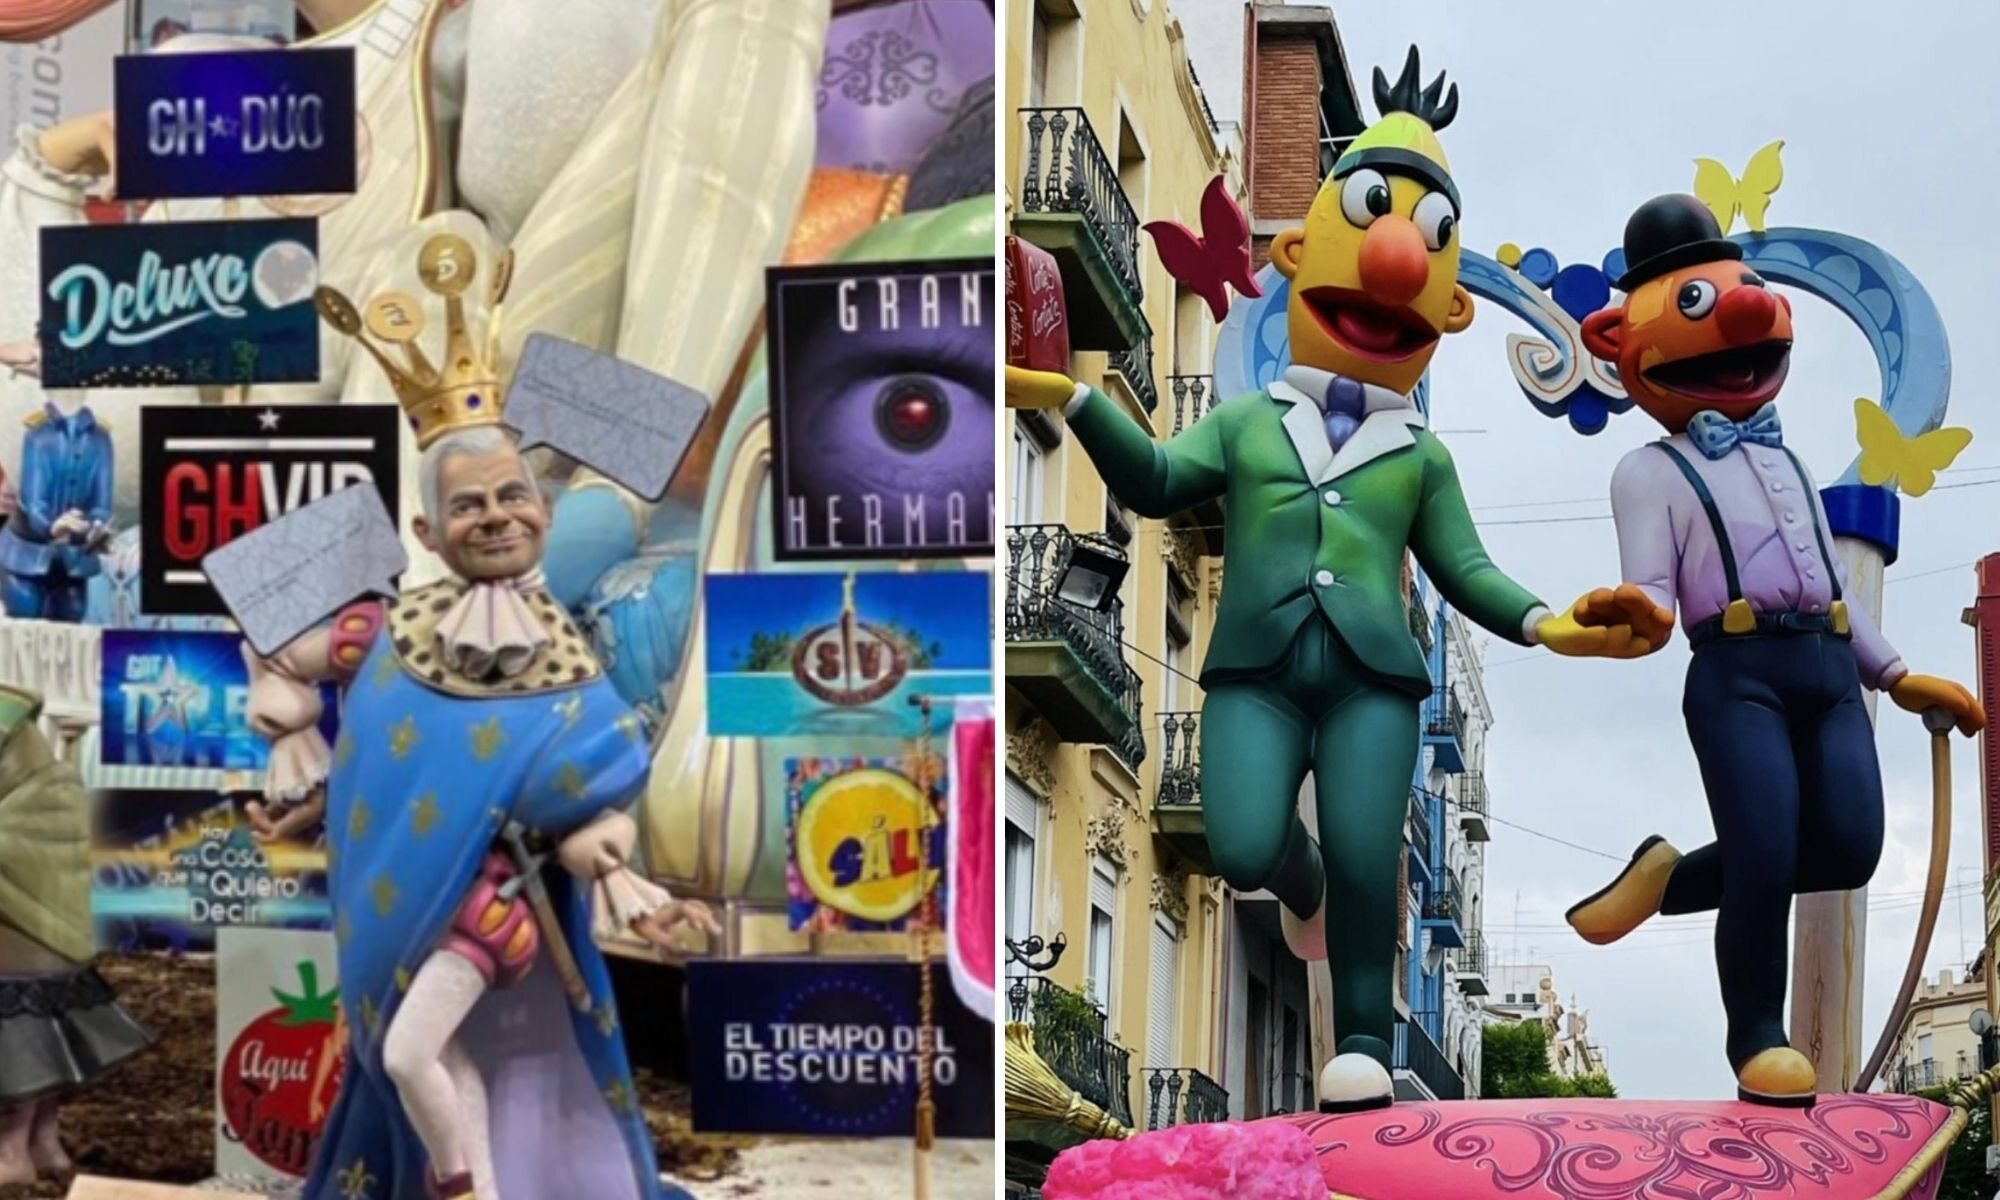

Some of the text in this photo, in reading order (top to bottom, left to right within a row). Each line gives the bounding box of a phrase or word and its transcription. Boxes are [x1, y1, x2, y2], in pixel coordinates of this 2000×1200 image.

[148, 82, 324, 156] GH DÚO
[48, 250, 249, 348] Deluxe
[837, 272, 982, 332] GRAN
[201, 841, 269, 868] Cosa
[209, 870, 300, 897] Quiero
[189, 898, 261, 922] Decir
[724, 1022, 955, 1053] EL TIEMPO DEL
[239, 1039, 315, 1091] Aquí
[725, 1052, 957, 1085] DESCUENTO
